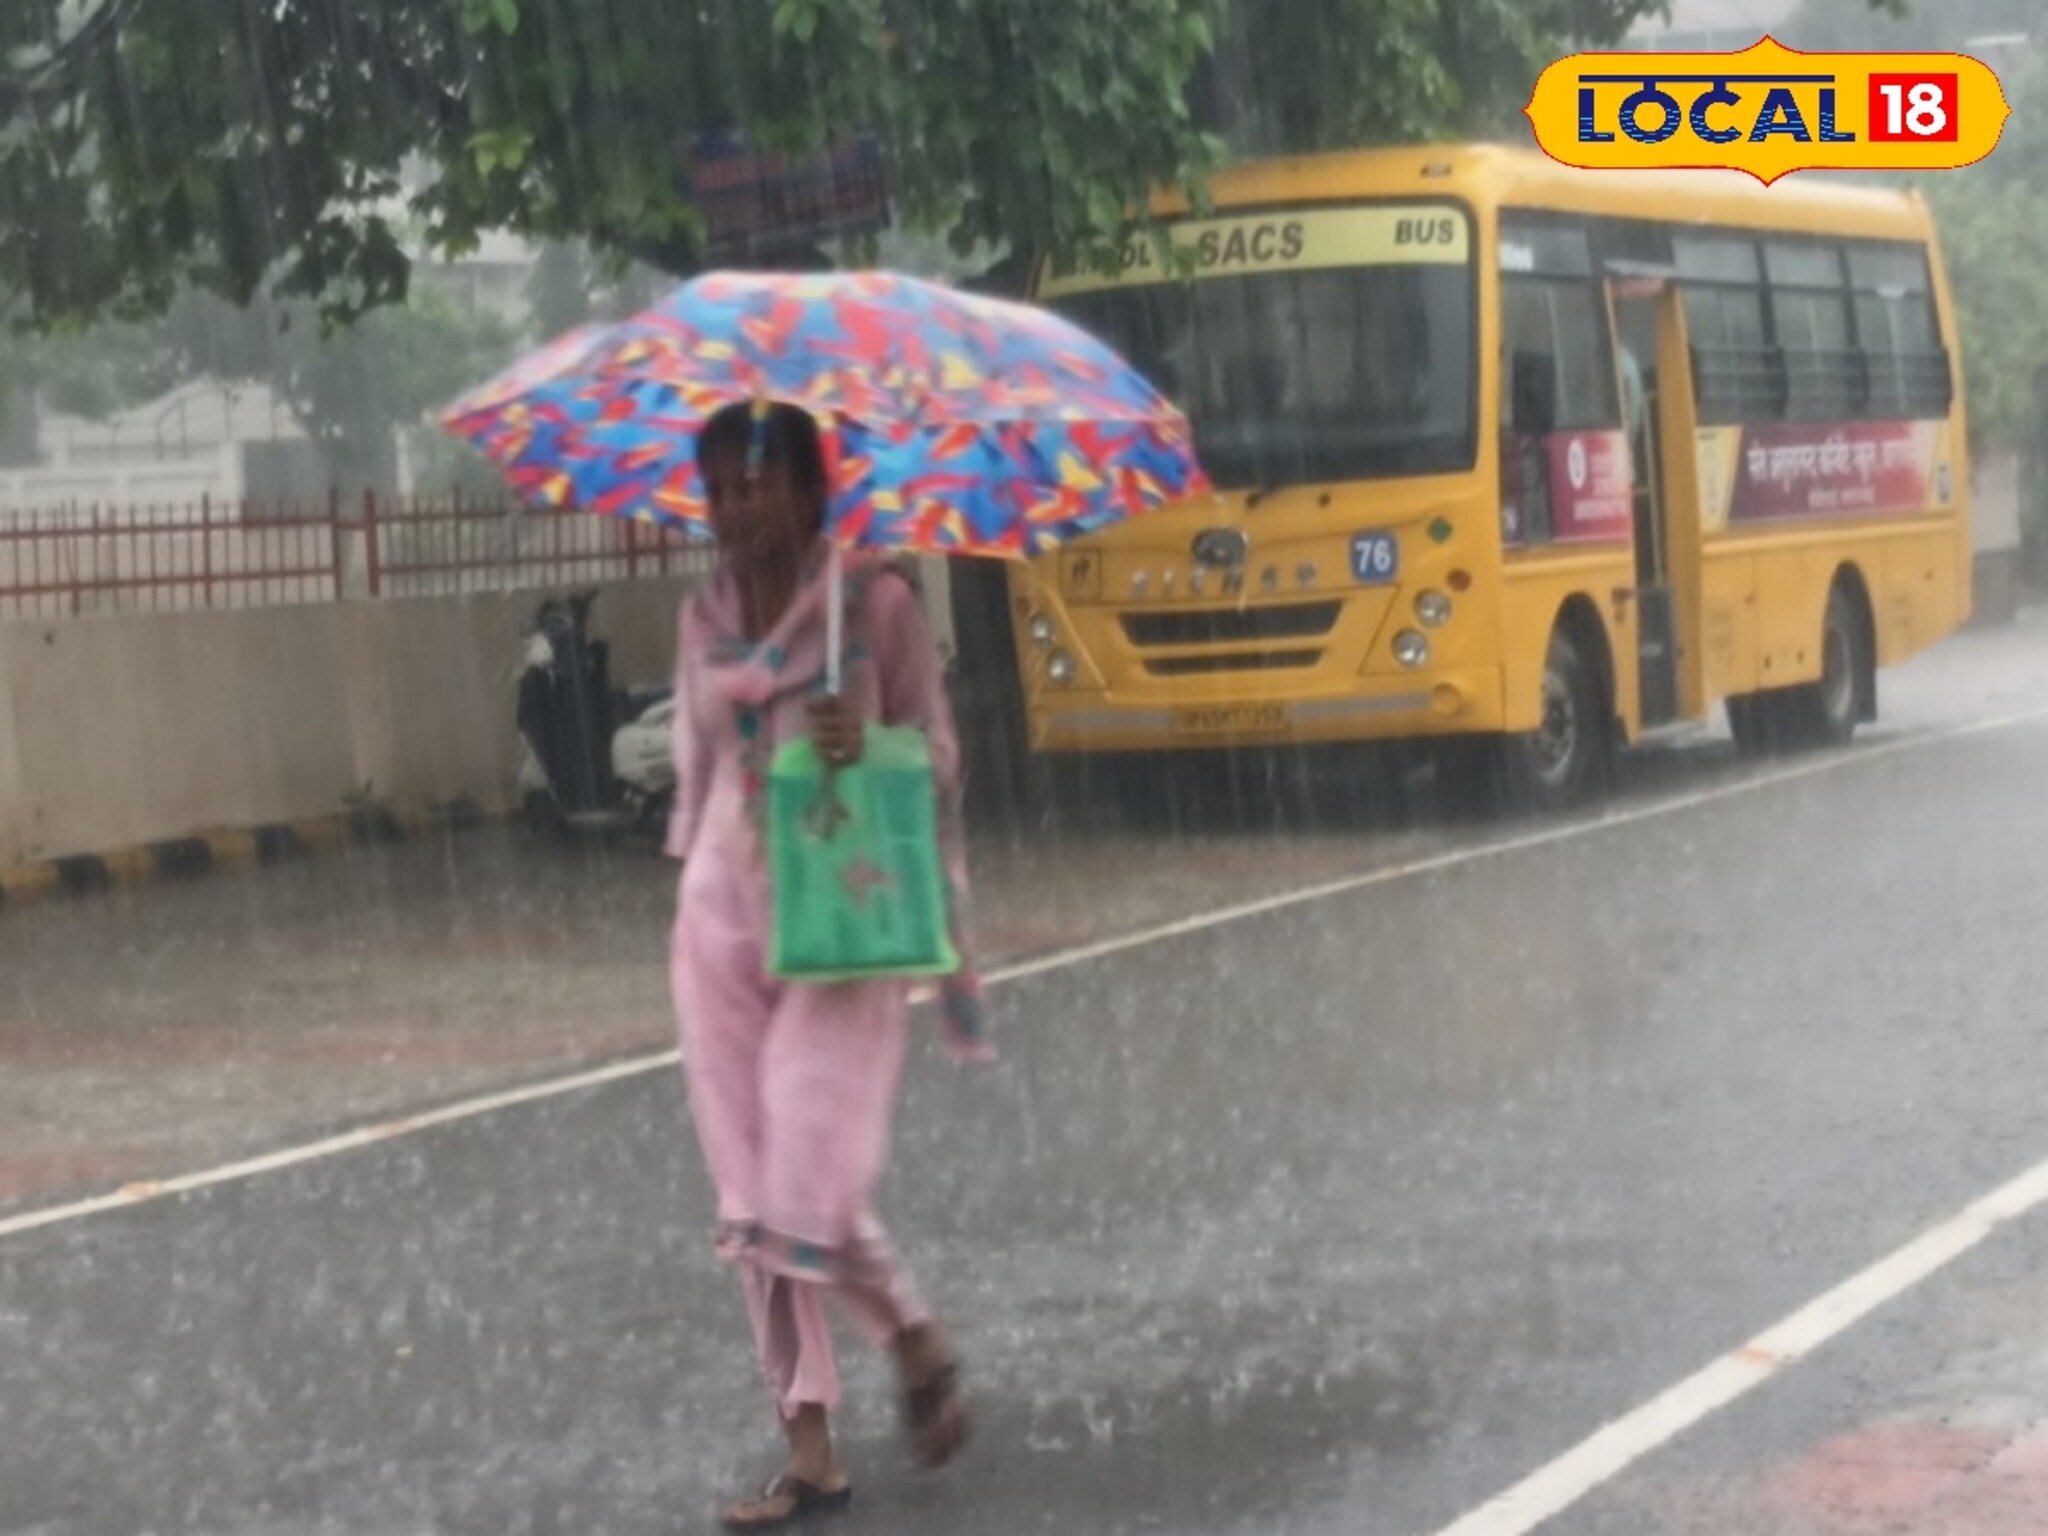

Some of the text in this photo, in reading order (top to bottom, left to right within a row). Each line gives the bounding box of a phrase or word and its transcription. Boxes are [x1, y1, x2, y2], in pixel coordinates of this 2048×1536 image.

[1198, 218, 1455, 267] SACS BUS
[1355, 540, 1391, 573] 76
